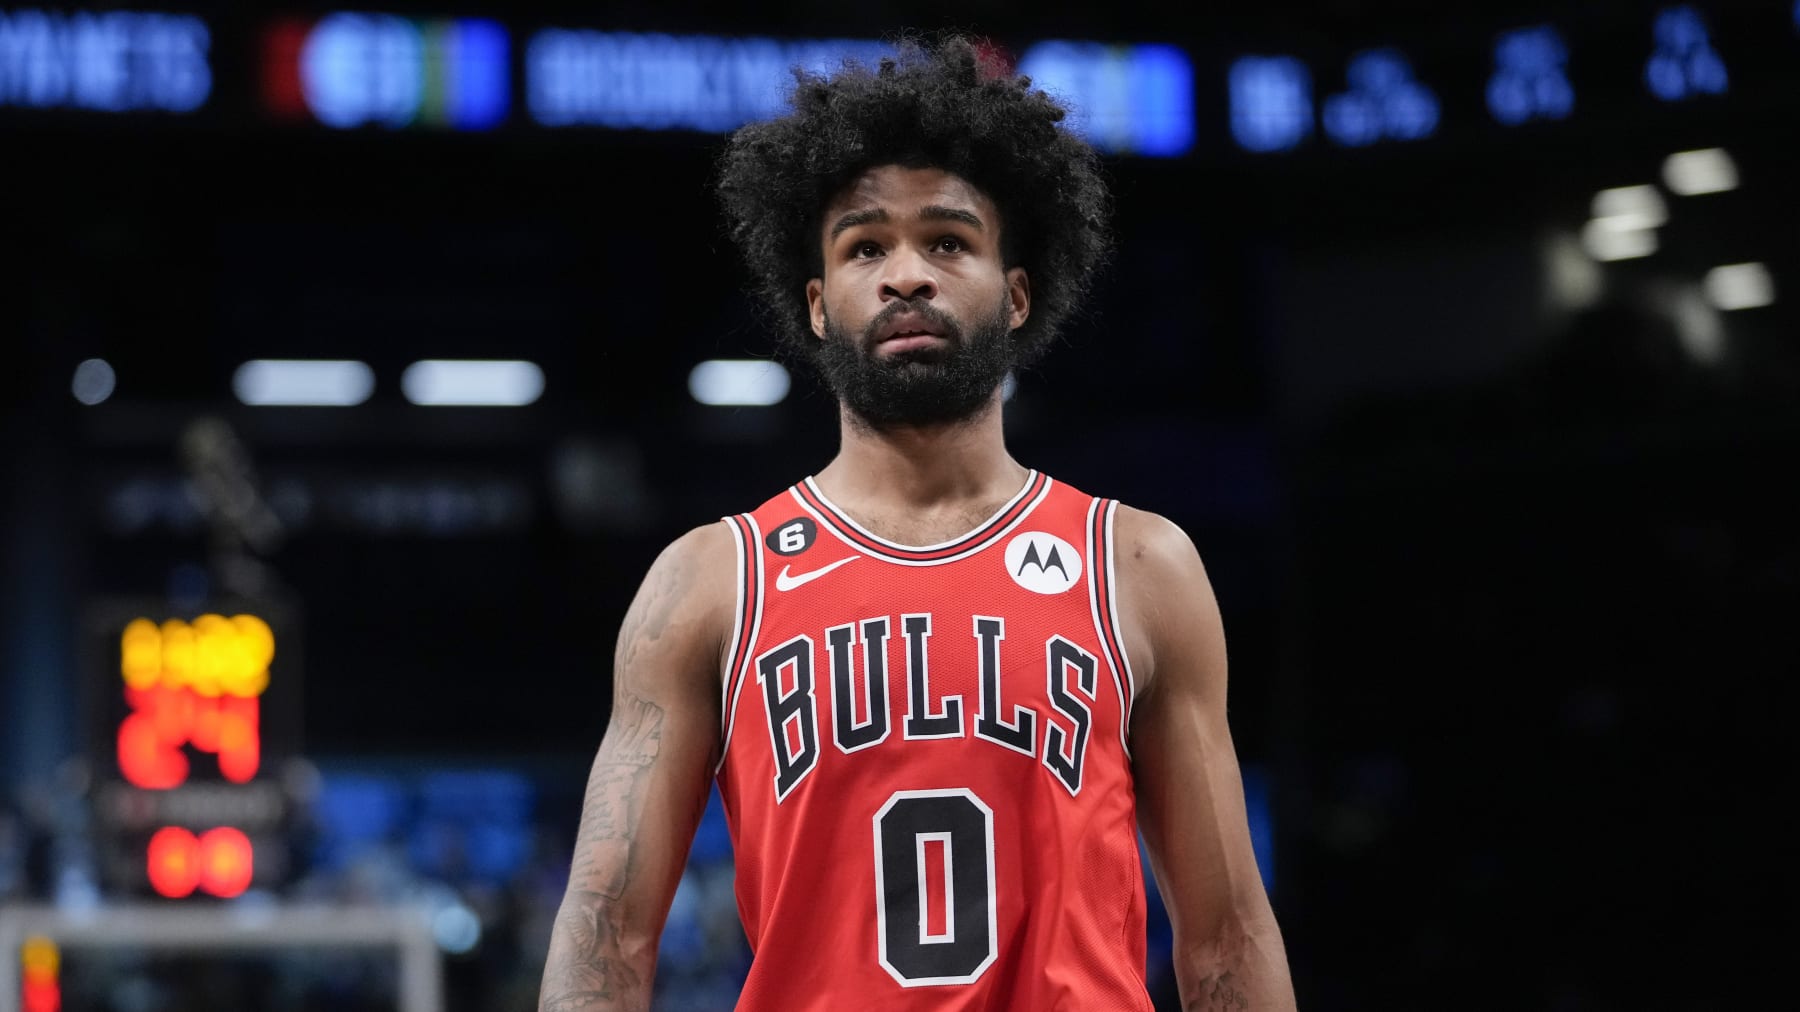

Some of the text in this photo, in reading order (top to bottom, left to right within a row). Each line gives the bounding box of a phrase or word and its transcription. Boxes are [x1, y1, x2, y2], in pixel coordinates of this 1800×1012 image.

[779, 523, 805, 552] 6
[756, 614, 1098, 804] BULLS
[873, 788, 998, 988] 0
